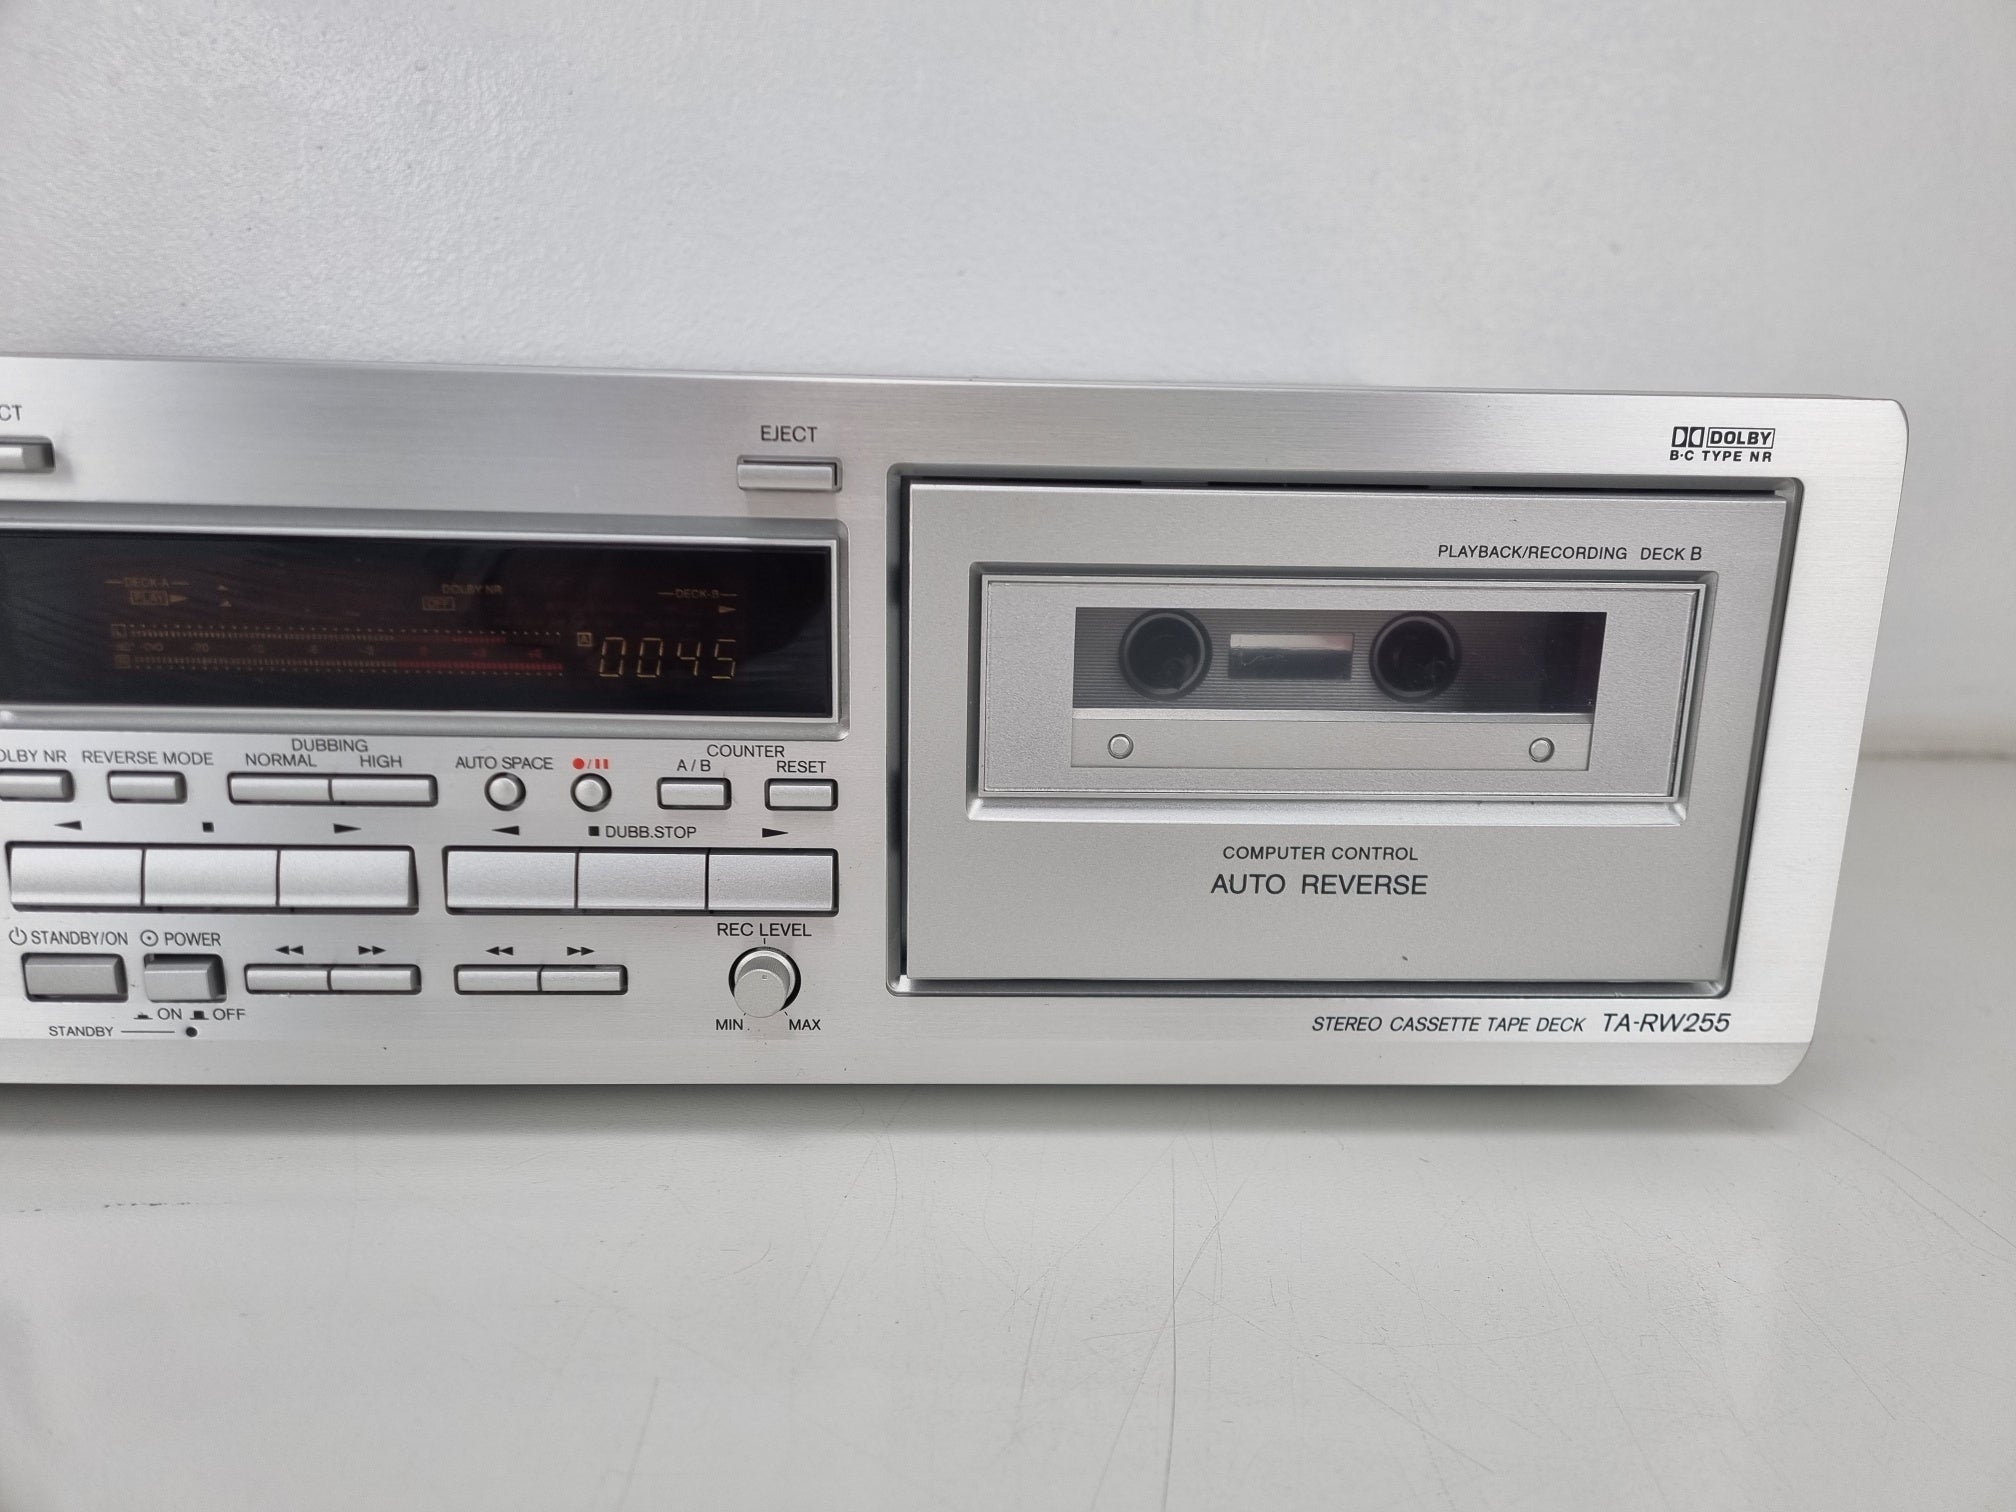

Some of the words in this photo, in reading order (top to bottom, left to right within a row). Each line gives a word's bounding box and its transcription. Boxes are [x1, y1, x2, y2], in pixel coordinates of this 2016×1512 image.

[760, 424, 818, 443] EJECT
[1709, 430, 1772, 446] DOLBY
[1701, 449, 1743, 462] TYPE
[1749, 450, 1773, 463] NR
[1438, 544, 1628, 560] PLAYBACK/RECORDING
[1640, 546, 1686, 561] DECK
[1689, 546, 1702, 561] B
[599, 636, 736, 680] 0045
[291, 738, 369, 753] DUBBING
[706, 743, 785, 758] COUNTER
[43, 749, 68, 763] NR
[82, 750, 158, 765] REVERSE
[162, 751, 214, 766] MODE
[245, 752, 318, 768] NORMAL
[359, 754, 403, 769] HIGH
[455, 755, 498, 770] AUTO
[501, 756, 555, 771] SPACE
[776, 760, 827, 774] RESET
[605, 825, 697, 839] DUBB.STOP
[1222, 845, 1326, 861] COMPUTER
[1331, 846, 1419, 861] CONTROL
[1210, 873, 1286, 895] AUTO
[1301, 873, 1429, 896] REVERSE
[716, 922, 754, 937] REC
[759, 922, 813, 937] LEVEL
[30, 930, 129, 946] STANDBY/ON
[164, 931, 222, 947] POWER
[157, 1007, 183, 1021] ON
[212, 1007, 246, 1021] OFF
[715, 1018, 744, 1031] MIN
[788, 1018, 822, 1031] MAX
[1311, 1016, 1383, 1032] STEREO
[1389, 1016, 1482, 1032] CASSETTE
[1487, 1016, 1532, 1032] TAPE
[1535, 1016, 1587, 1033] DECK
[1603, 1012, 1732, 1033] TA-RW255
[48, 1025, 114, 1038] STANDBY
